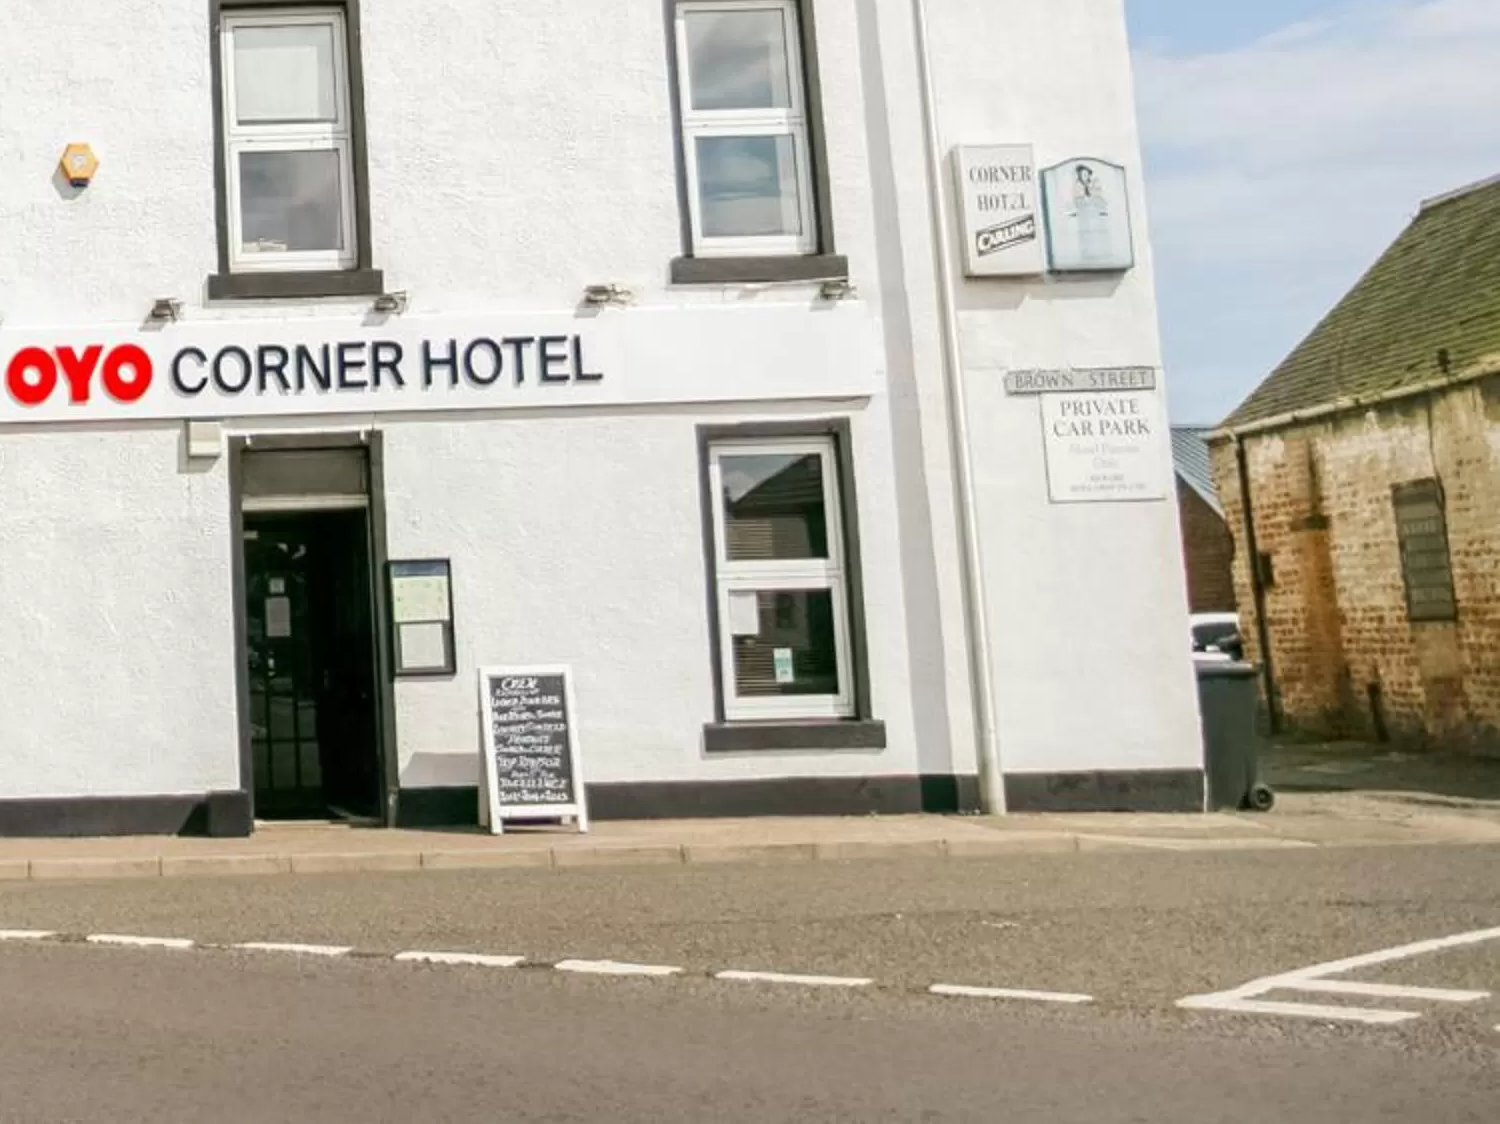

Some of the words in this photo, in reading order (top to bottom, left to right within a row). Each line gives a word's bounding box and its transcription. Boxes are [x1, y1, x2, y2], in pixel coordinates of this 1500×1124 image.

[969, 165, 1032, 182] CORNER
[977, 192, 1031, 212] HOTEL
[5, 343, 153, 405] OYO
[171, 341, 405, 395] CORNER
[421, 334, 604, 389] HOTEL
[1014, 372, 1074, 389] BROWN
[1089, 370, 1148, 387] STREET
[1060, 398, 1140, 417] PRIVATE
[1053, 419, 1094, 437] CAR
[1100, 419, 1151, 436] PARK
